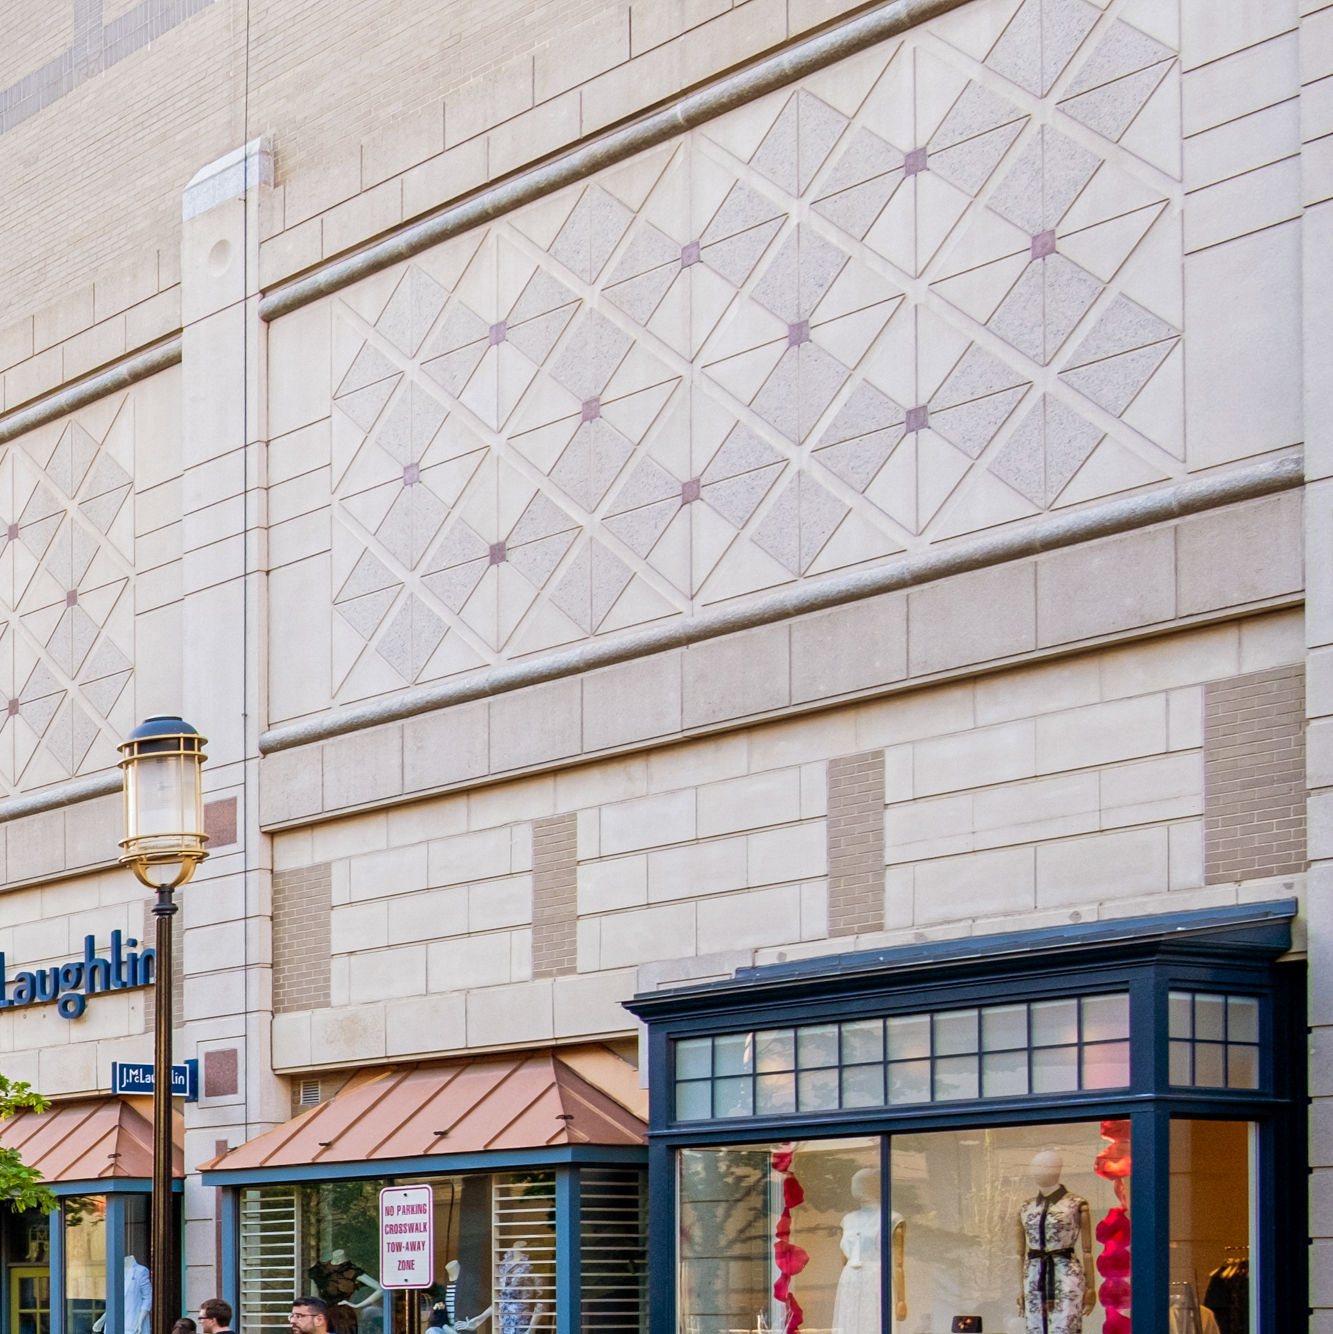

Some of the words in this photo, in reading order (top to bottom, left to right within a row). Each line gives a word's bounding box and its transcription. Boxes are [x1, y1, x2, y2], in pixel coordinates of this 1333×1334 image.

[121, 1067, 185, 1088] J.McLalin
[384, 1205, 395, 1217] NO
[396, 1203, 428, 1216] PARKING
[384, 1222, 428, 1235] CROSSWALK
[386, 1240, 426, 1253] TOW-AWAY
[397, 1260, 415, 1271] ZONE
